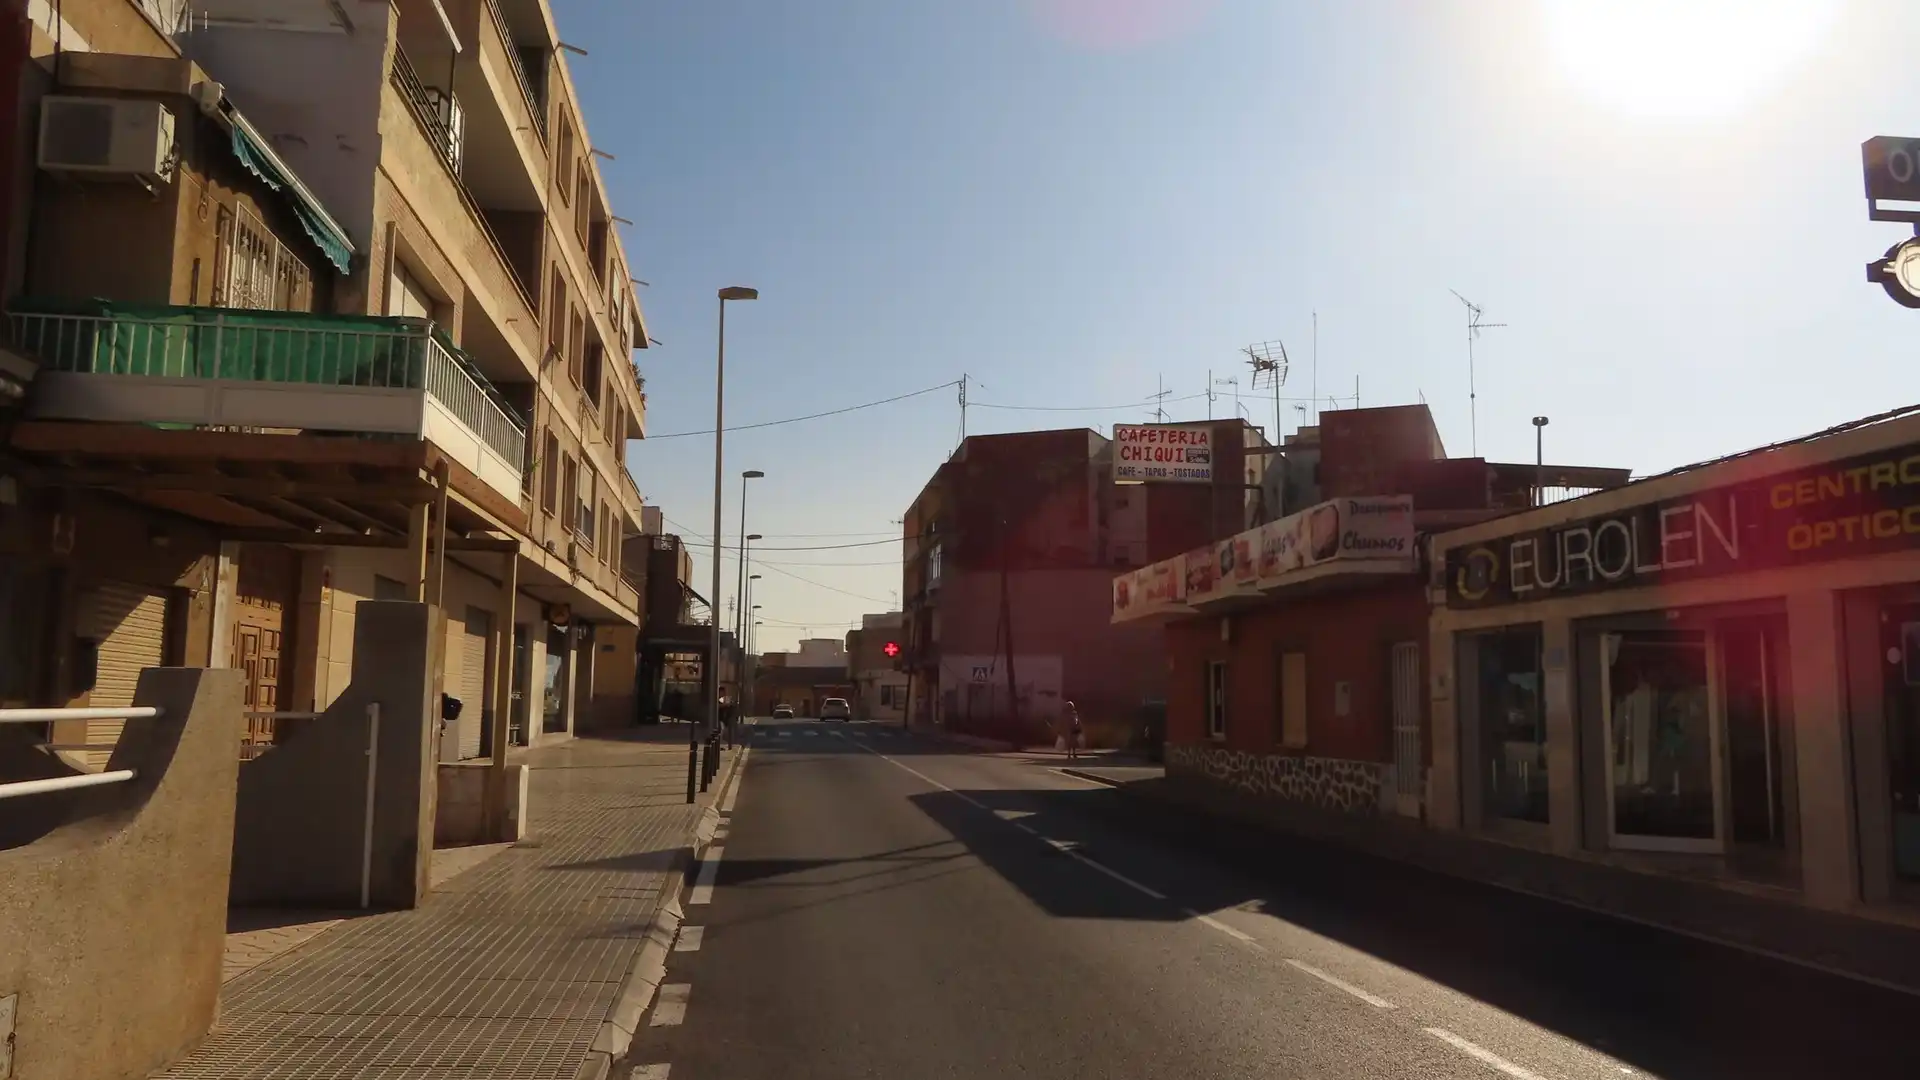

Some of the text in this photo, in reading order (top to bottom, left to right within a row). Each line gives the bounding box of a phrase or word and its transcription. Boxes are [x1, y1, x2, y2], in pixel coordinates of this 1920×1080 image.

[1118, 428, 1208, 445] CAFETERIA
[1120, 445, 1184, 463] CHIQUI
[1117, 466, 1136, 477] CAFE
[1145, 467, 1167, 477] TAPAS
[1771, 455, 1920, 510] CENTRO
[1510, 493, 1739, 593] EUROLEN
